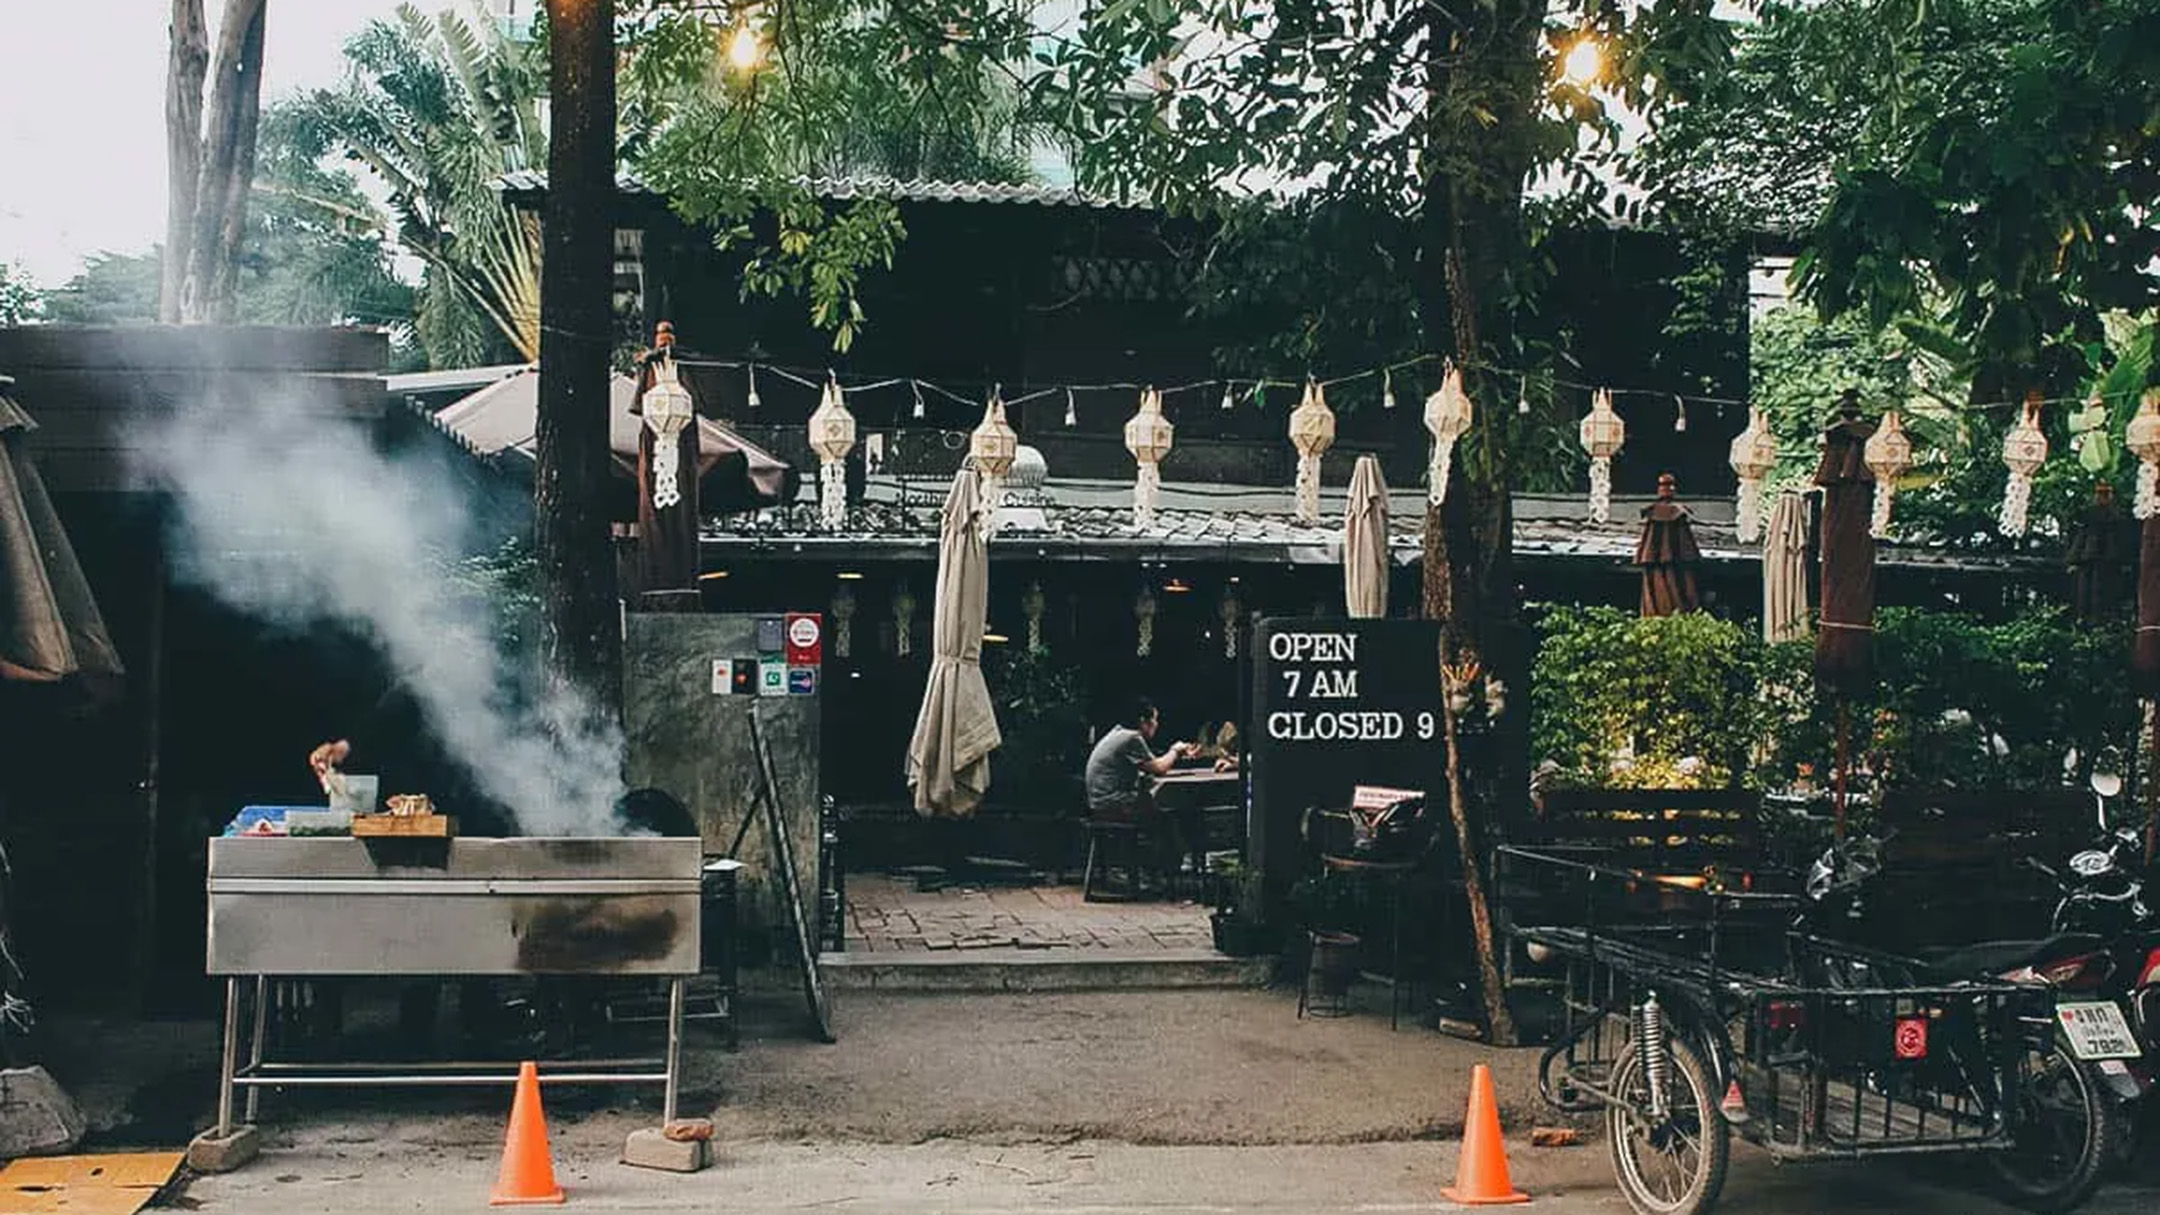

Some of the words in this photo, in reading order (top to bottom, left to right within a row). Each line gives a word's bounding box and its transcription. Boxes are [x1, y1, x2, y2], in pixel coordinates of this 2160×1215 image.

[1269, 633, 1358, 661] OPEN
[1283, 670, 1301, 698] 7
[1309, 670, 1358, 698] AM
[1268, 712, 1404, 739] CLOSED
[1417, 712, 1435, 739] 9
